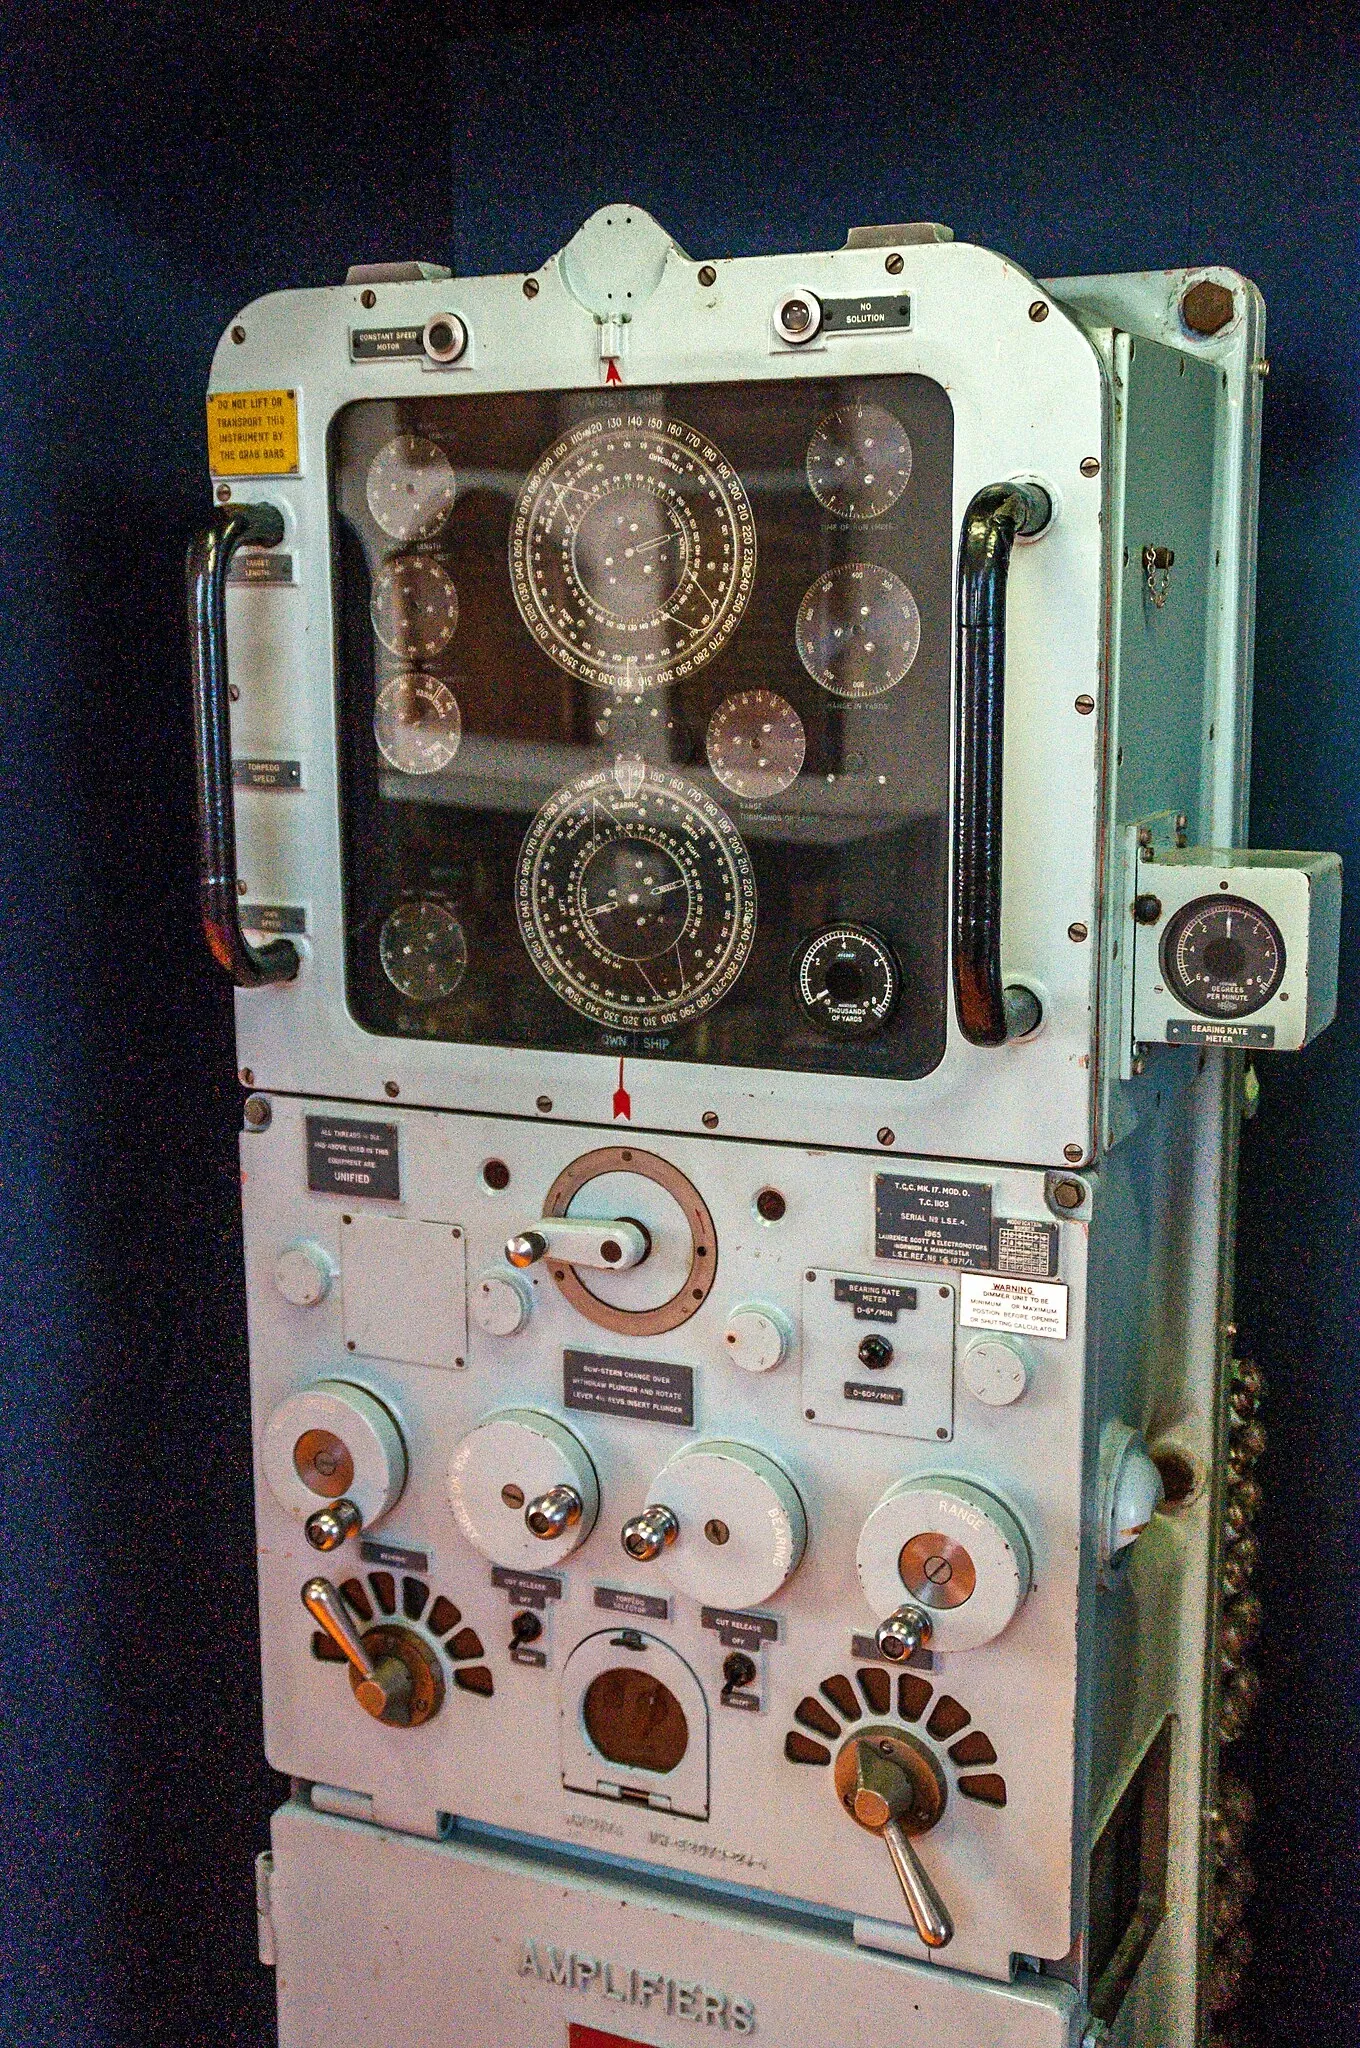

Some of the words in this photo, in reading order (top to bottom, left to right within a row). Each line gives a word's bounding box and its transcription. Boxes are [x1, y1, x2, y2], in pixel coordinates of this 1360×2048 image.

[860, 302, 872, 311] NO
[846, 313, 885, 324] SOLUTION
[360, 332, 394, 342] CONSTANT
[396, 331, 417, 340] SPEED
[377, 343, 400, 352] MOTOR
[217, 399, 228, 409] DO
[232, 398, 246, 409] NOT
[251, 397, 268, 409] LIFT
[271, 397, 282, 407] OR
[217, 416, 262, 428] TRANSPORT
[267, 415, 285, 425] THIS
[608, 417, 622, 428] 130
[628, 416, 642, 427] 140
[648, 418, 663, 429] 150
[219, 431, 269, 443] INSTRUMENT
[272, 431, 283, 441] BY
[667, 422, 682, 437] 160
[686, 432, 701, 448] 170
[220, 450, 235, 461] THE
[239, 449, 260, 460] GRAB
[263, 449, 285, 459] BARS
[553, 443, 568, 459] 100
[702, 446, 717, 462] 180
[539, 458, 554, 476] 090
[649, 452, 684, 474] STARBOARD
[717, 462, 731, 480] 190
[528, 475, 541, 494] 080
[728, 481, 742, 500] 200
[520, 495, 532, 514] 070
[738, 503, 749, 521] 210
[515, 517, 526, 536] 060
[743, 525, 753, 545] 220
[514, 538, 523, 558] 050
[744, 548, 753, 568] 230
[515, 561, 524, 580] 040
[733, 593, 746, 613] 250
[525, 603, 538, 621] 020
[536, 623, 549, 639] 010
[722, 614, 737, 633] 260
[709, 632, 725, 650] 270
[548, 644, 558, 655] N
[694, 648, 710, 665] 280
[676, 661, 693, 676] 290
[559, 791, 572, 805] 100
[688, 788, 702, 802] 170
[544, 804, 559, 820] 090
[704, 801, 718, 817] 180
[718, 818, 731, 834] 190
[526, 838, 537, 856] 070
[685, 841, 701, 859] RIGHT
[729, 836, 743, 855] 200
[738, 858, 749, 874] 210
[524, 921, 536, 939] 030
[1202, 925, 1207, 933] 2
[1253, 926, 1258, 934] 2
[531, 941, 544, 959] 020
[842, 942, 847, 950] 4
[816, 958, 820, 966] 2
[724, 962, 739, 980] 260
[1257, 975, 1262, 983] 6
[1222, 994, 1250, 1002] MINUTE
[661, 1012, 678, 1024] 300
[680, 1004, 697, 1019] 290
[828, 1007, 866, 1015] THOUSANDS
[623, 1014, 639, 1026] 320
[1192, 1025, 1226, 1035] BEARING
[1227, 1027, 1248, 1036] RATE
[644, 1037, 670, 1050] SHIP
[1206, 1035, 1233, 1043] METER
[334, 1172, 370, 1184] UNIFIED
[901, 1213, 927, 1222] SERIAL
[878, 1233, 909, 1243] LAURENCE
[910, 1237, 929, 1245] SCOTT
[937, 1241, 988, 1251] ELECTROMOTORS
[931, 1247, 970, 1257] MANCHESTER
[849, 1285, 881, 1295] BEARING
[882, 1289, 901, 1297] RATE
[983, 1291, 1010, 1299] DIMMER
[993, 1283, 1033, 1295] WARNING
[863, 1295, 887, 1304] METER
[971, 1299, 1002, 1307] MINIMUM
[1023, 1305, 1057, 1314] MAXIMUM
[973, 1308, 1000, 1316] POSTION
[1004, 1312, 1028, 1320] BEFORE
[1032, 1316, 1060, 1324] OPENING
[1014, 1323, 1057, 1333] CALCULATOR
[583, 1365, 623, 1377] BOW-STERN
[624, 1372, 651, 1382] CHANGE
[653, 1376, 671, 1384] OVER
[609, 1384, 638, 1393] PLUNGER
[656, 1390, 682, 1400] ROTATE
[573, 1391, 593, 1400] LEVER
[627, 1400, 651, 1409] INSERT
[653, 1404, 683, 1414] PLUNGER
[940, 1501, 985, 1531] RANGE
[768, 1508, 787, 1568] BEARING
[716, 1618, 730, 1626] CUT
[732, 1621, 762, 1633] RELEASE
[519, 1937, 756, 2036] AMPLIFIERS
